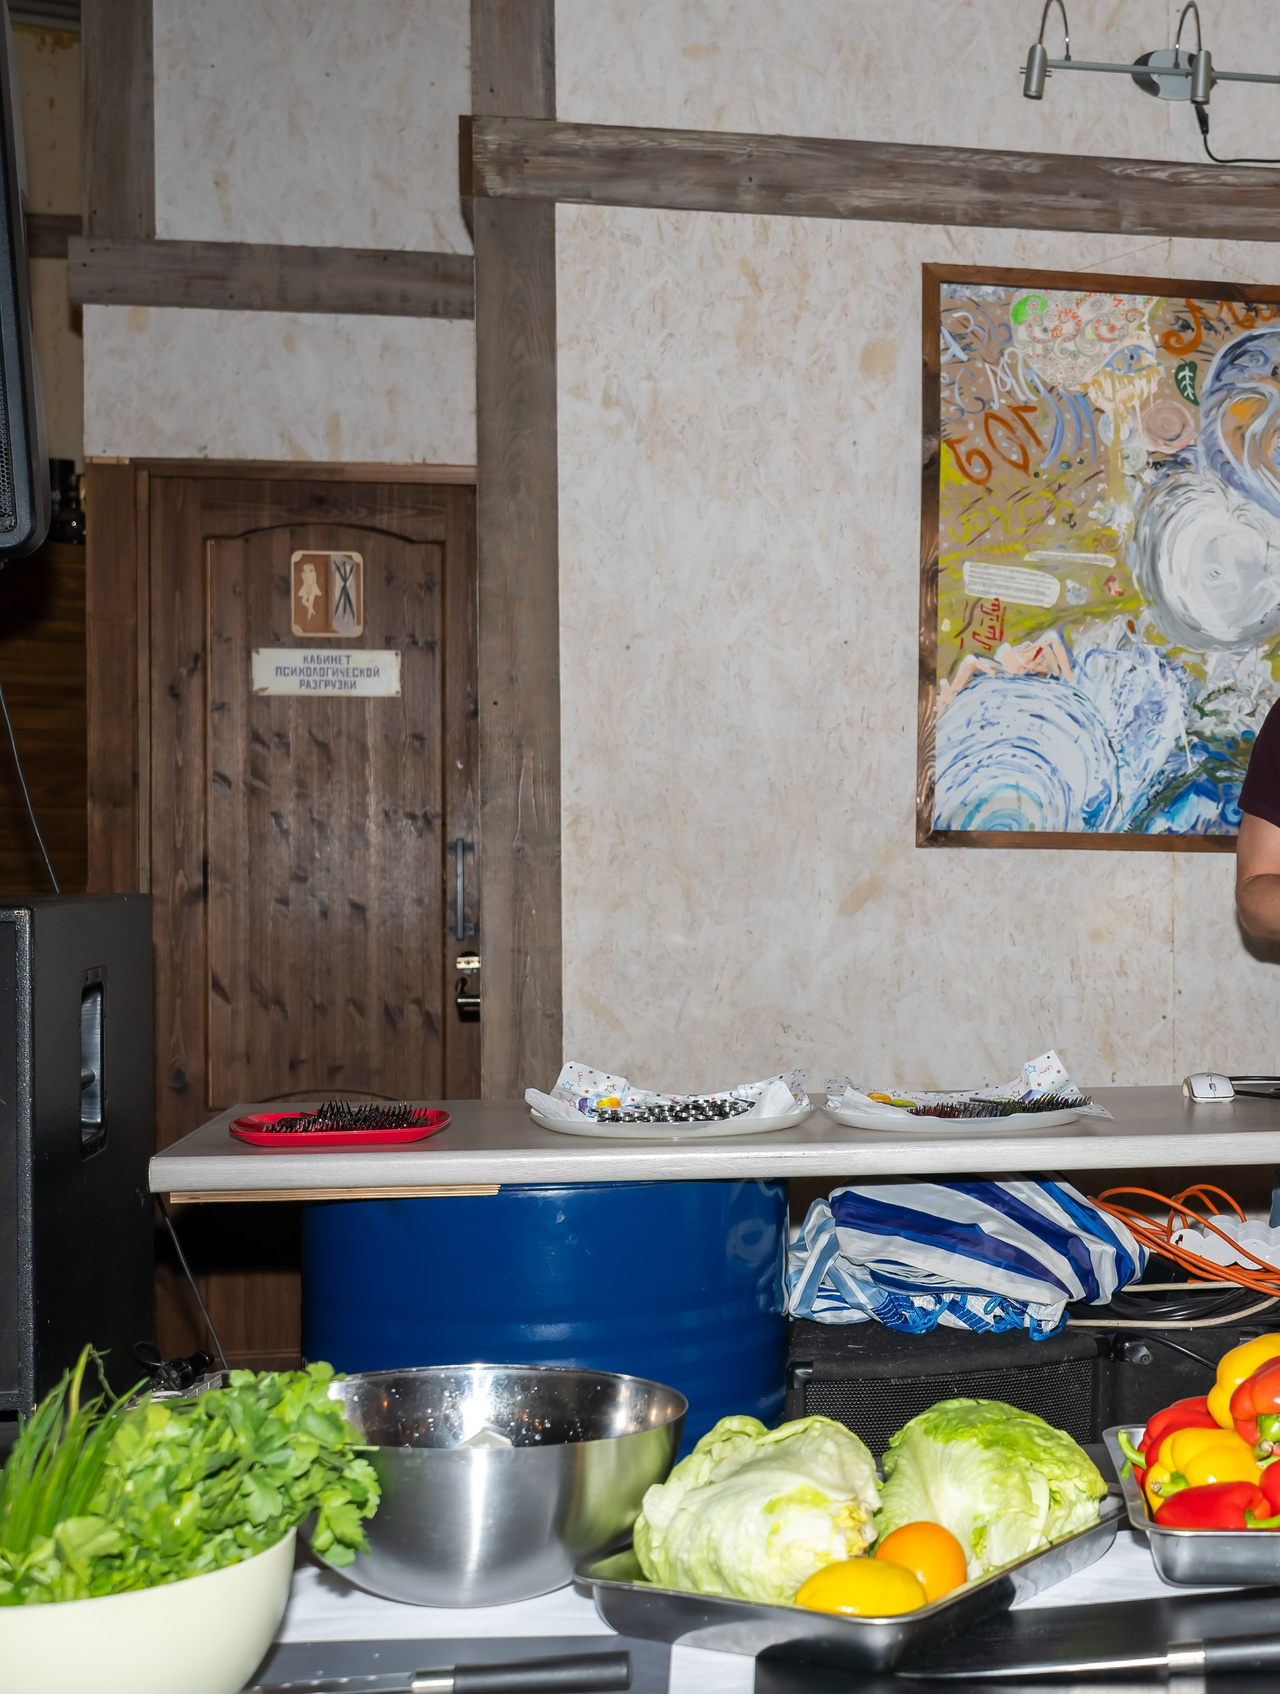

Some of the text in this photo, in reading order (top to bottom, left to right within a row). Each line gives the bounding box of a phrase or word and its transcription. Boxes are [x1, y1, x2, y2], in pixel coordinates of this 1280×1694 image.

[303, 654, 352, 666] КАБИНЕТ
[275, 665, 380, 678] ПСИХОЛОГИЧЕСКОЙ
[300, 679, 357, 690] РАЗГРУЗКИ
